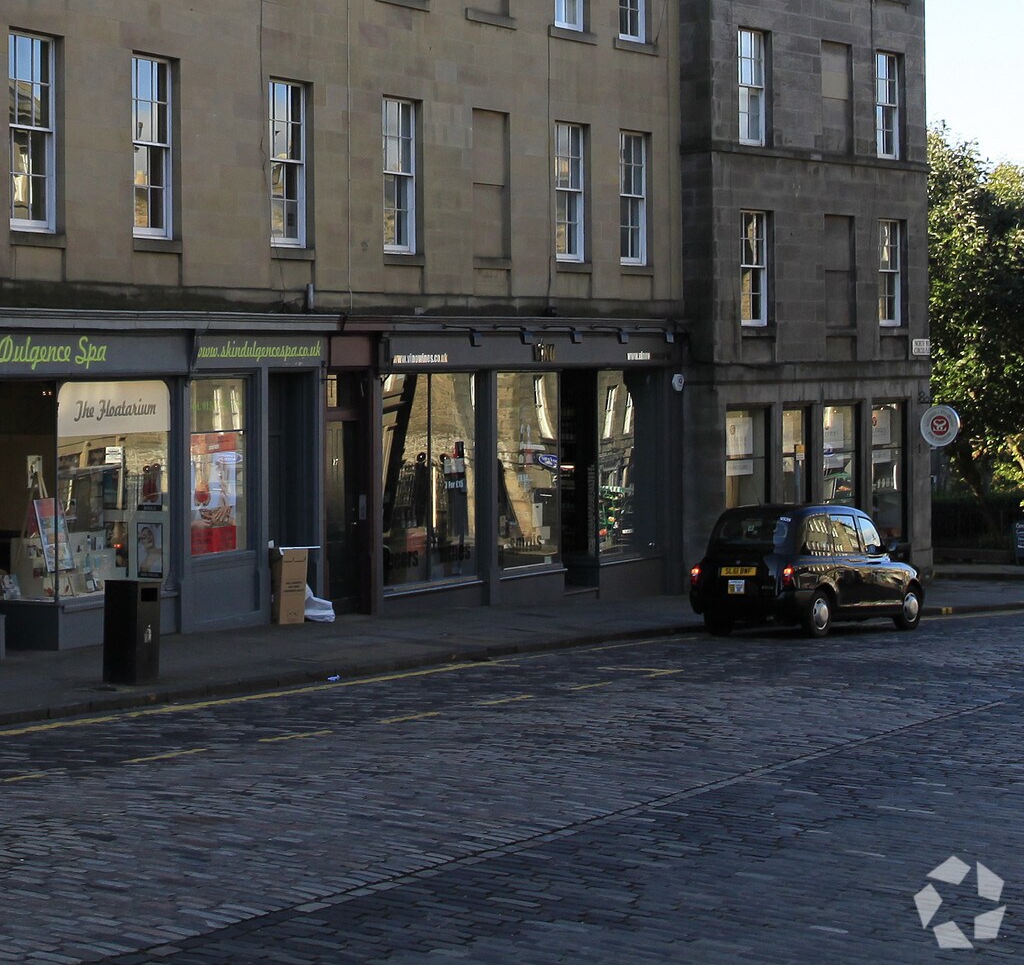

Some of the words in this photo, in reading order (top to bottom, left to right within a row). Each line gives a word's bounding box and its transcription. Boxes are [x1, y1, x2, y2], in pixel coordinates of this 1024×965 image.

[75, 335, 108, 370] Spa
[74, 400, 95, 422] The
[96, 398, 157, 421] Floatarium
